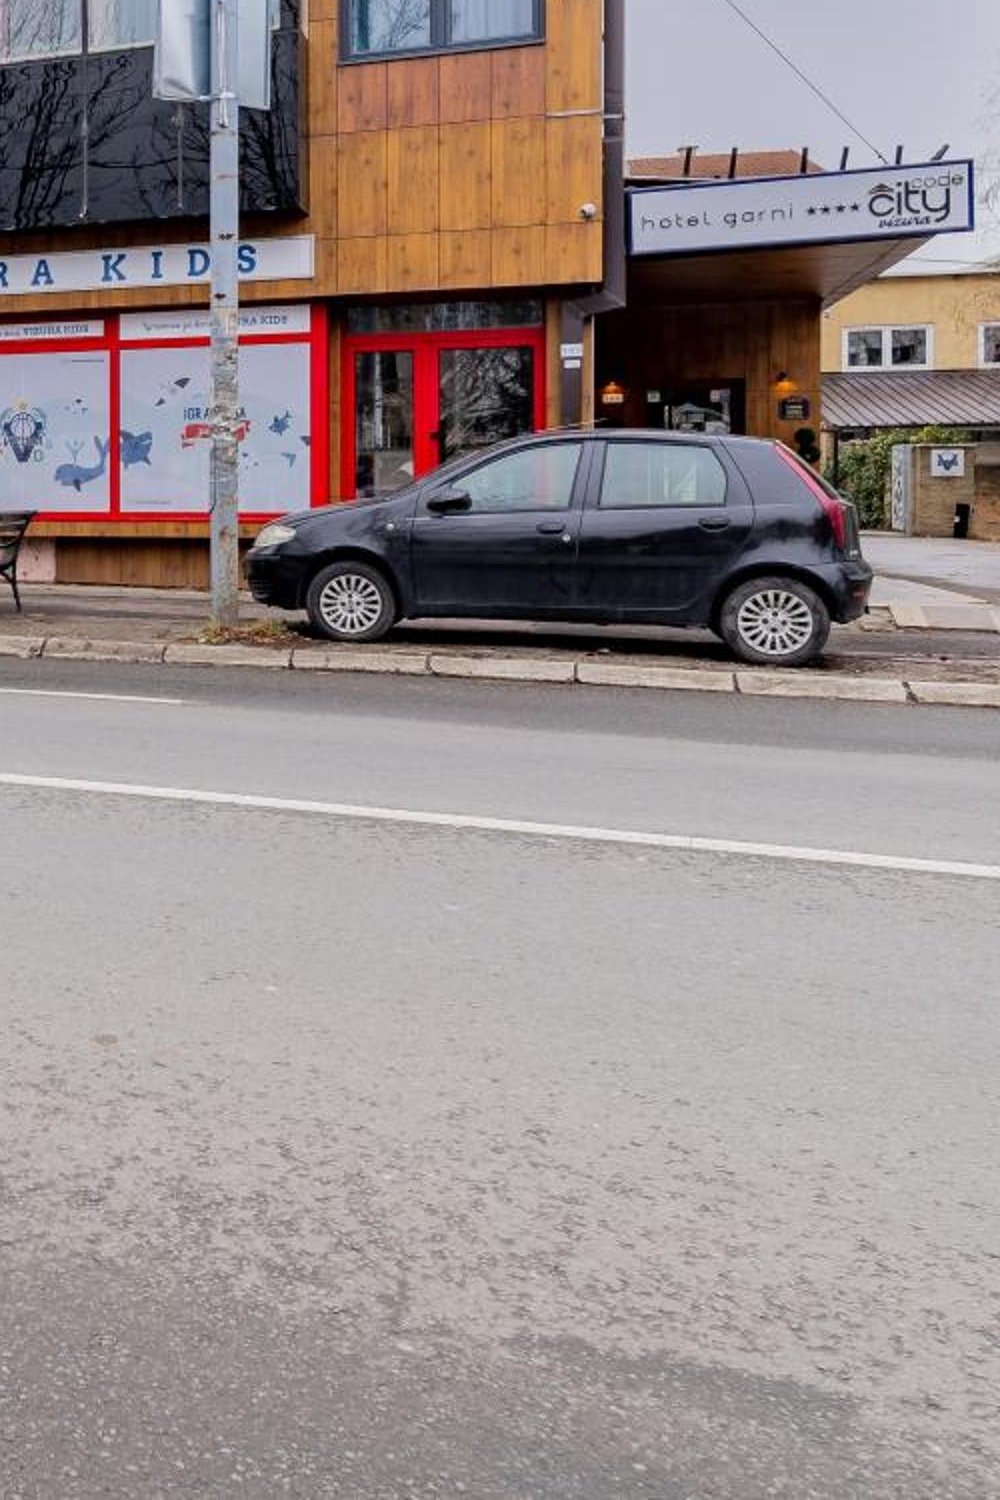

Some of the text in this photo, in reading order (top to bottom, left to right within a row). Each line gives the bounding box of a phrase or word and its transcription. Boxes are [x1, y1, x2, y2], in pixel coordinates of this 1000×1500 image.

[911, 169, 964, 189] code
[641, 202, 793, 231] hotel garni
[868, 182, 950, 223] city
[101, 244, 257, 282] KIDS
